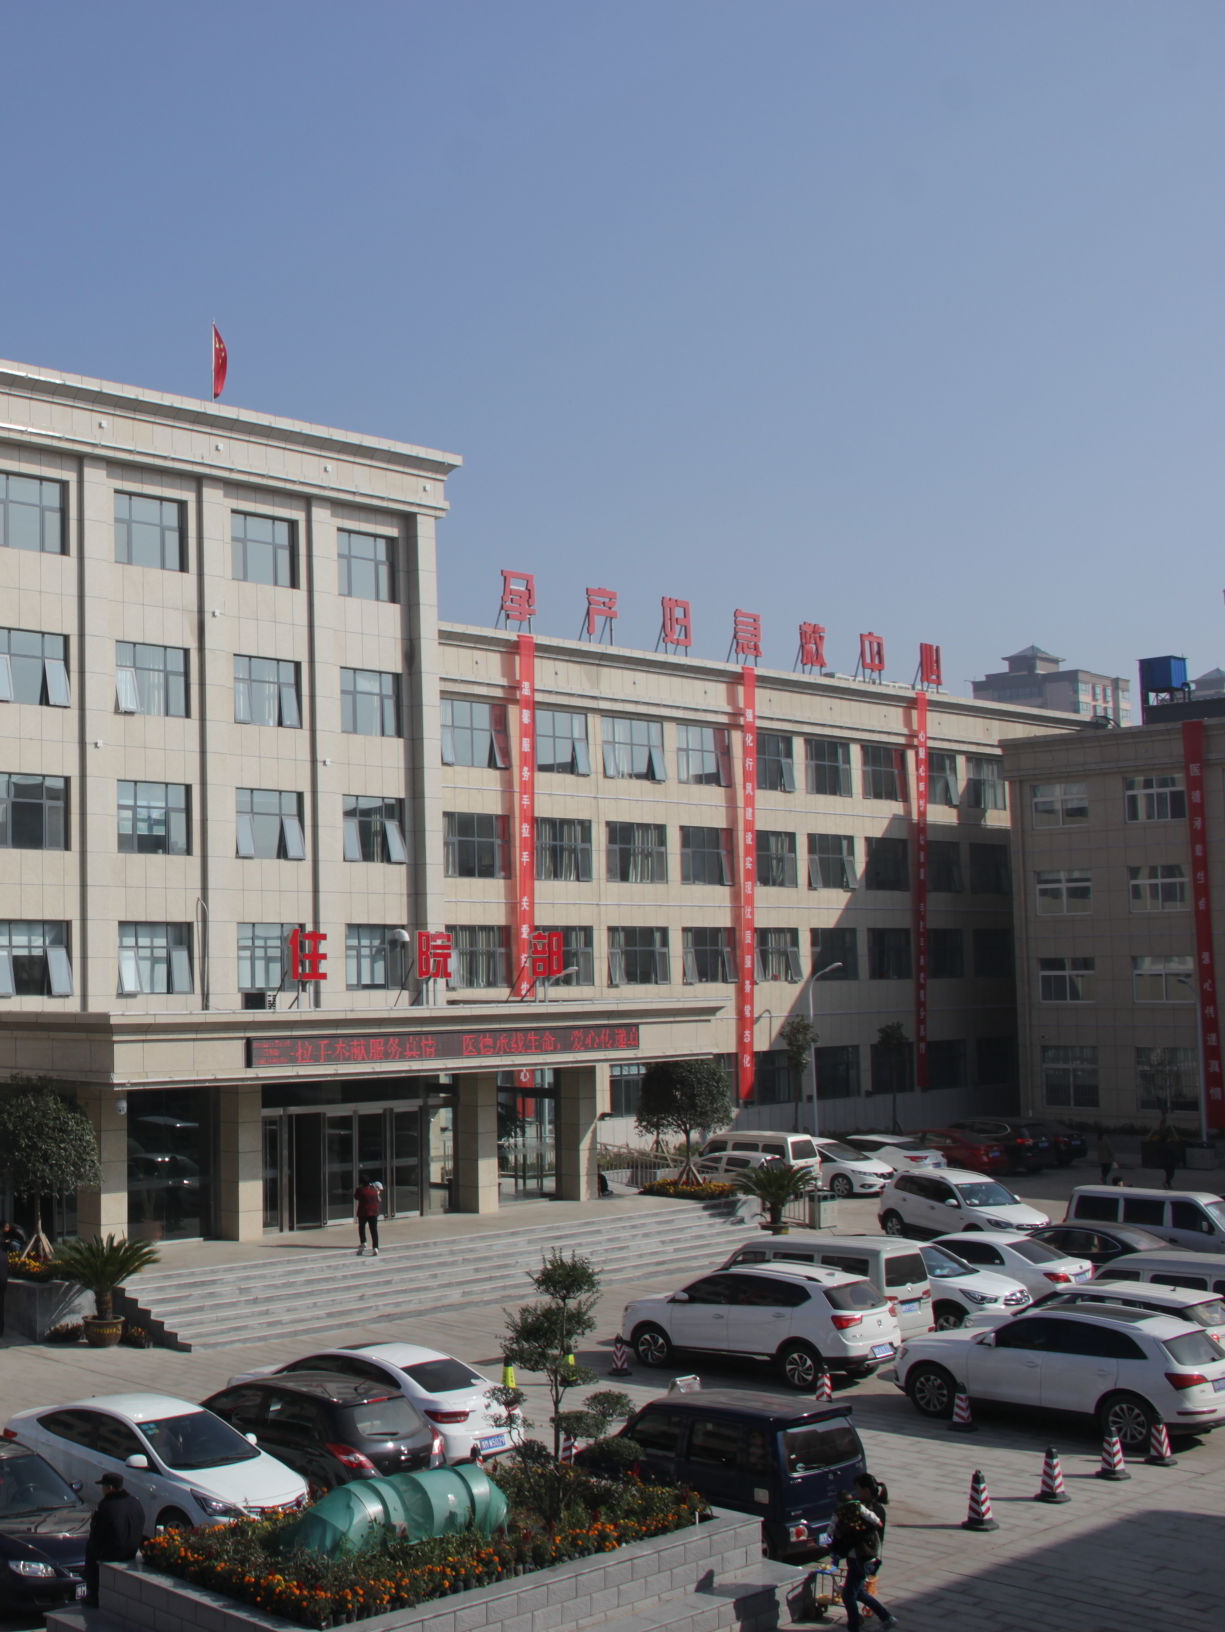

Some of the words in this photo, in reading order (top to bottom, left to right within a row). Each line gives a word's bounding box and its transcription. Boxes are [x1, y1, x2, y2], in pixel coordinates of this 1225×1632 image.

[500, 569, 943, 686] 孕产妇急救中心
[289, 928, 563, 980] 住院部
